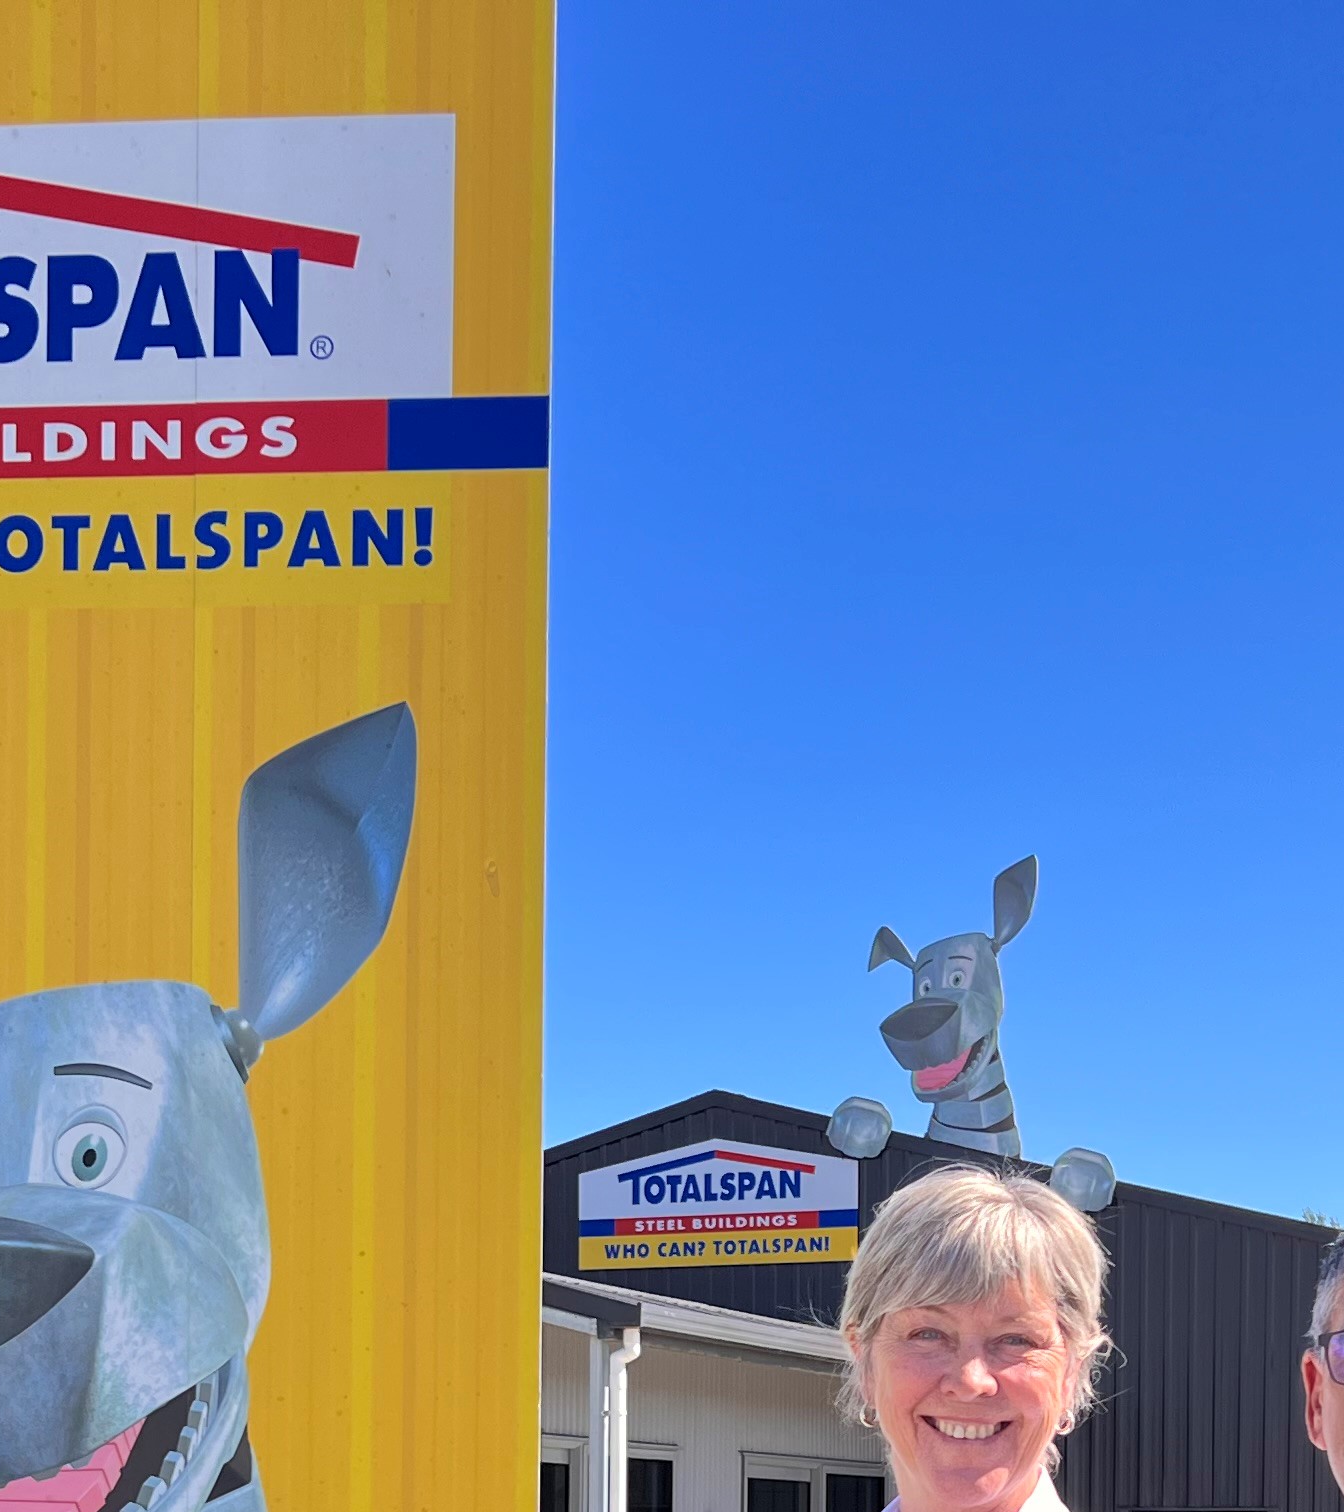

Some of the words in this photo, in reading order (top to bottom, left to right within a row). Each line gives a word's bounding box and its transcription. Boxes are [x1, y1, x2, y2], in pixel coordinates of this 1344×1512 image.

[617, 1166, 801, 1205] TOTALSPAN
[635, 1219, 685, 1232] STEEL
[692, 1215, 798, 1230] BUILDINGS
[604, 1244, 650, 1259] WHO
[657, 1241, 706, 1257] CAN?
[713, 1236, 830, 1255] TOTALSPAN!
